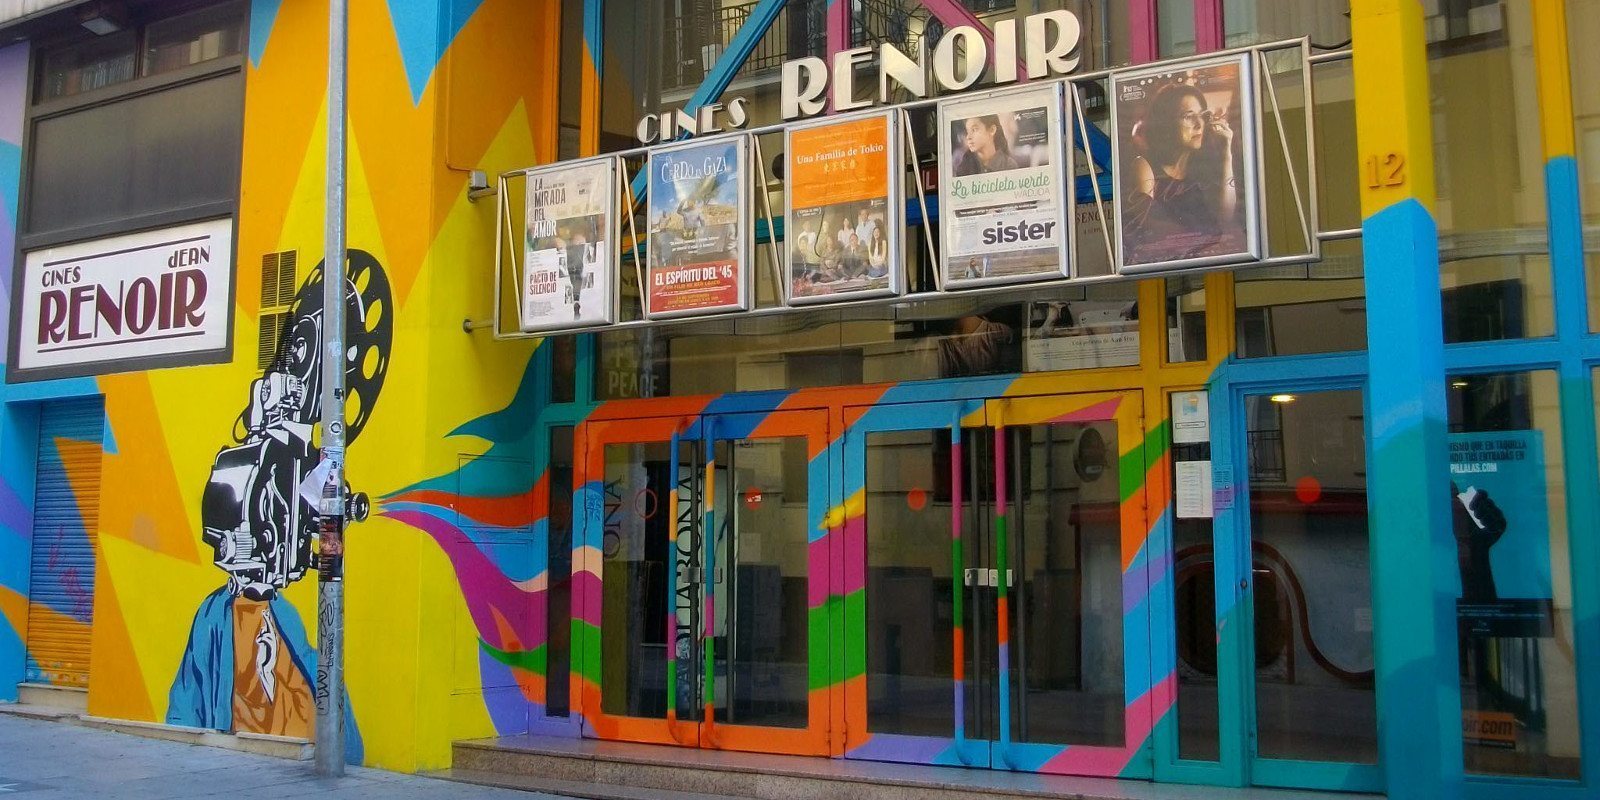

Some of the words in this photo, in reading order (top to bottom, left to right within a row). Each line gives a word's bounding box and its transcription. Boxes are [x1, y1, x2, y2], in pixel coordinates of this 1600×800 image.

[637, 96, 750, 143] CINES
[781, 9, 1081, 120] RENOIR
[797, 155, 814, 165] Una
[815, 149, 845, 161] Familia
[847, 147, 858, 156] de
[860, 143, 884, 155] Tokio
[1367, 152, 1406, 189] 12
[534, 177, 543, 191] LA
[951, 180, 969, 199] La
[971, 176, 1017, 195] bicicleta
[1017, 172, 1050, 189] verde
[534, 188, 566, 208] MIRADA
[534, 208, 545, 222] DEL
[533, 220, 557, 239] AMOR
[983, 219, 1056, 245] sister
[42, 265, 81, 288] CINES
[529, 272, 548, 285] PACTO
[549, 271, 557, 282] DE
[655, 272, 664, 286] EL
[666, 267, 701, 285] ESPÍRITU
[702, 266, 718, 281] DEL
[529, 283, 557, 296] SILENCIO
[38, 268, 208, 344] RENOIR
